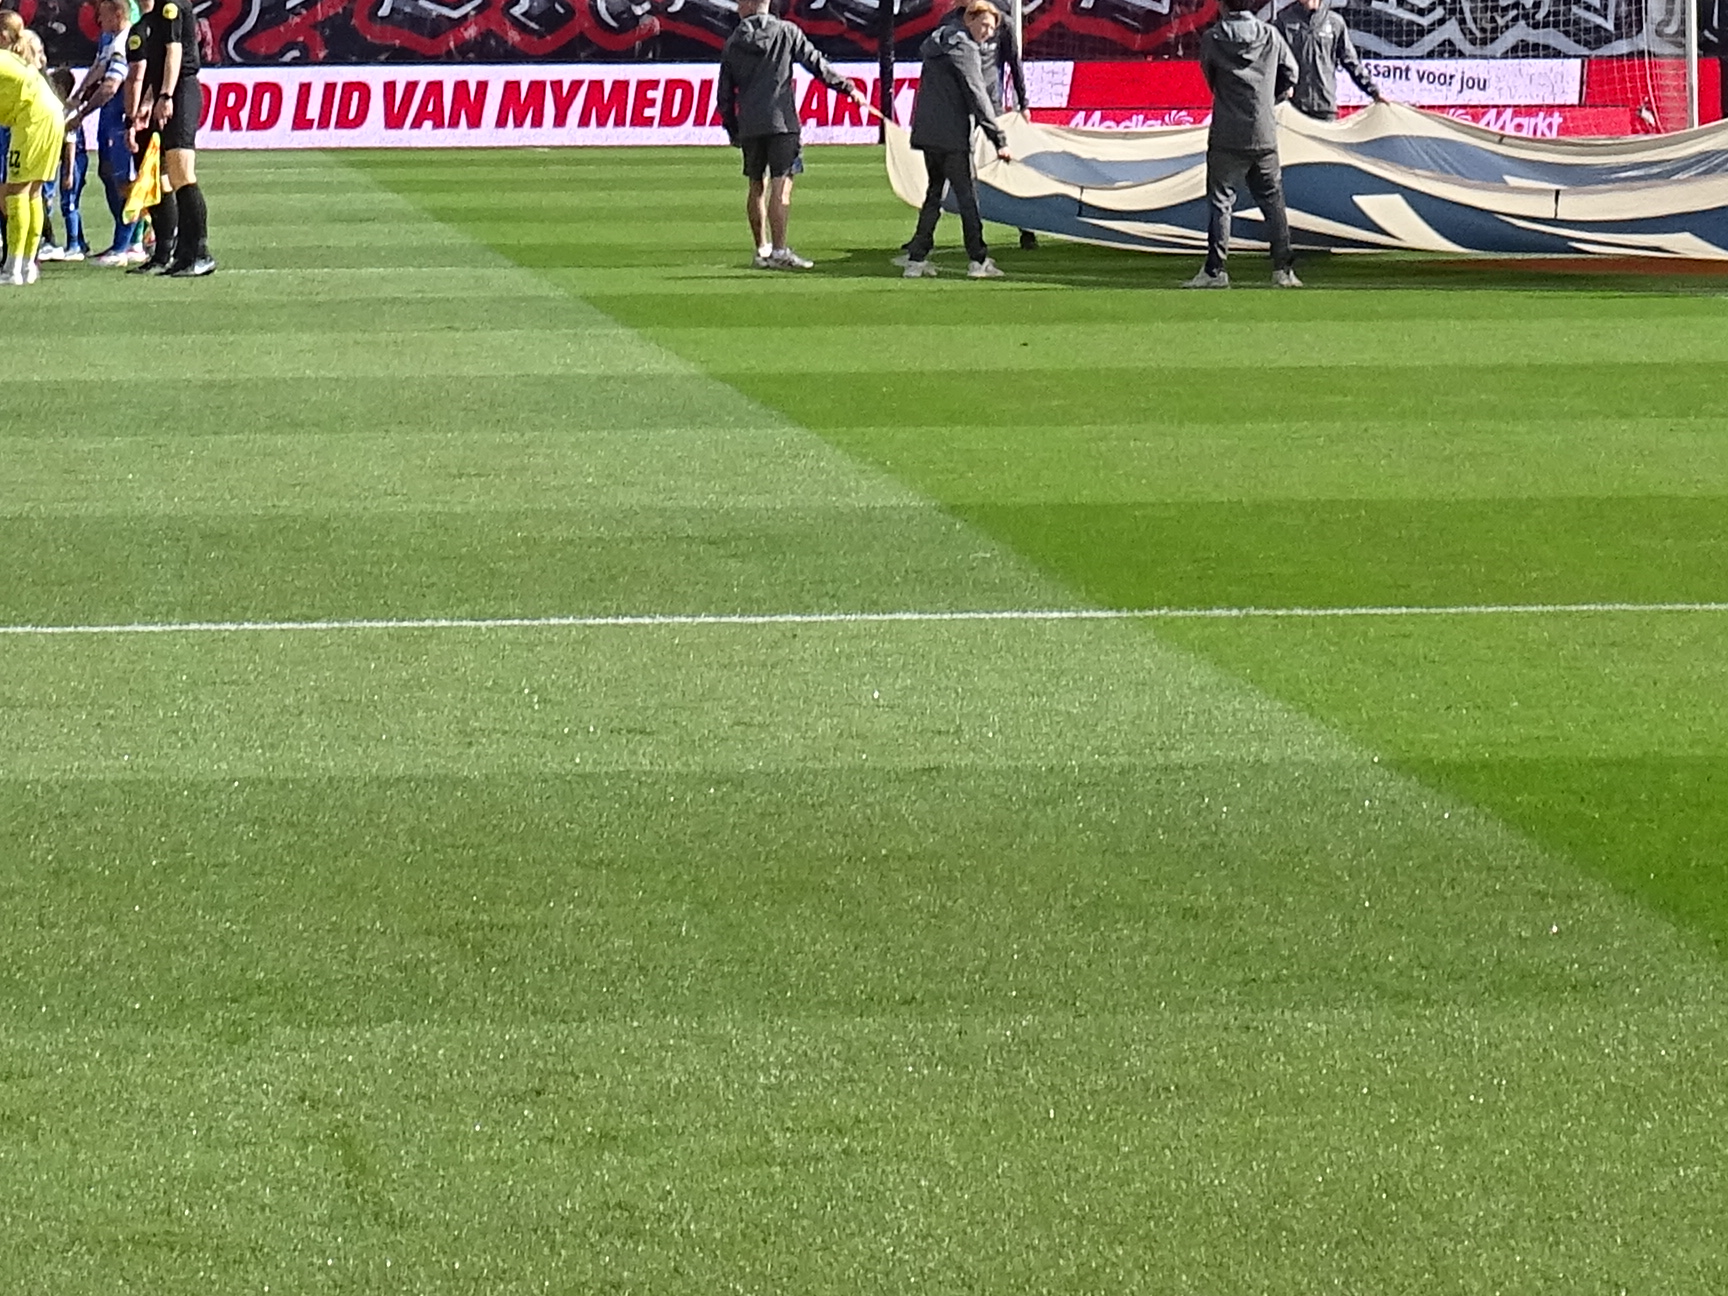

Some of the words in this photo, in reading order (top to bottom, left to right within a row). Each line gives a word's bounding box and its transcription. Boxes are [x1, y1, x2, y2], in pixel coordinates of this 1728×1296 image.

[1416, 67, 1456, 88] voor
[1458, 71, 1487, 94] jou
[292, 81, 372, 131] LID
[383, 79, 489, 130] VAN
